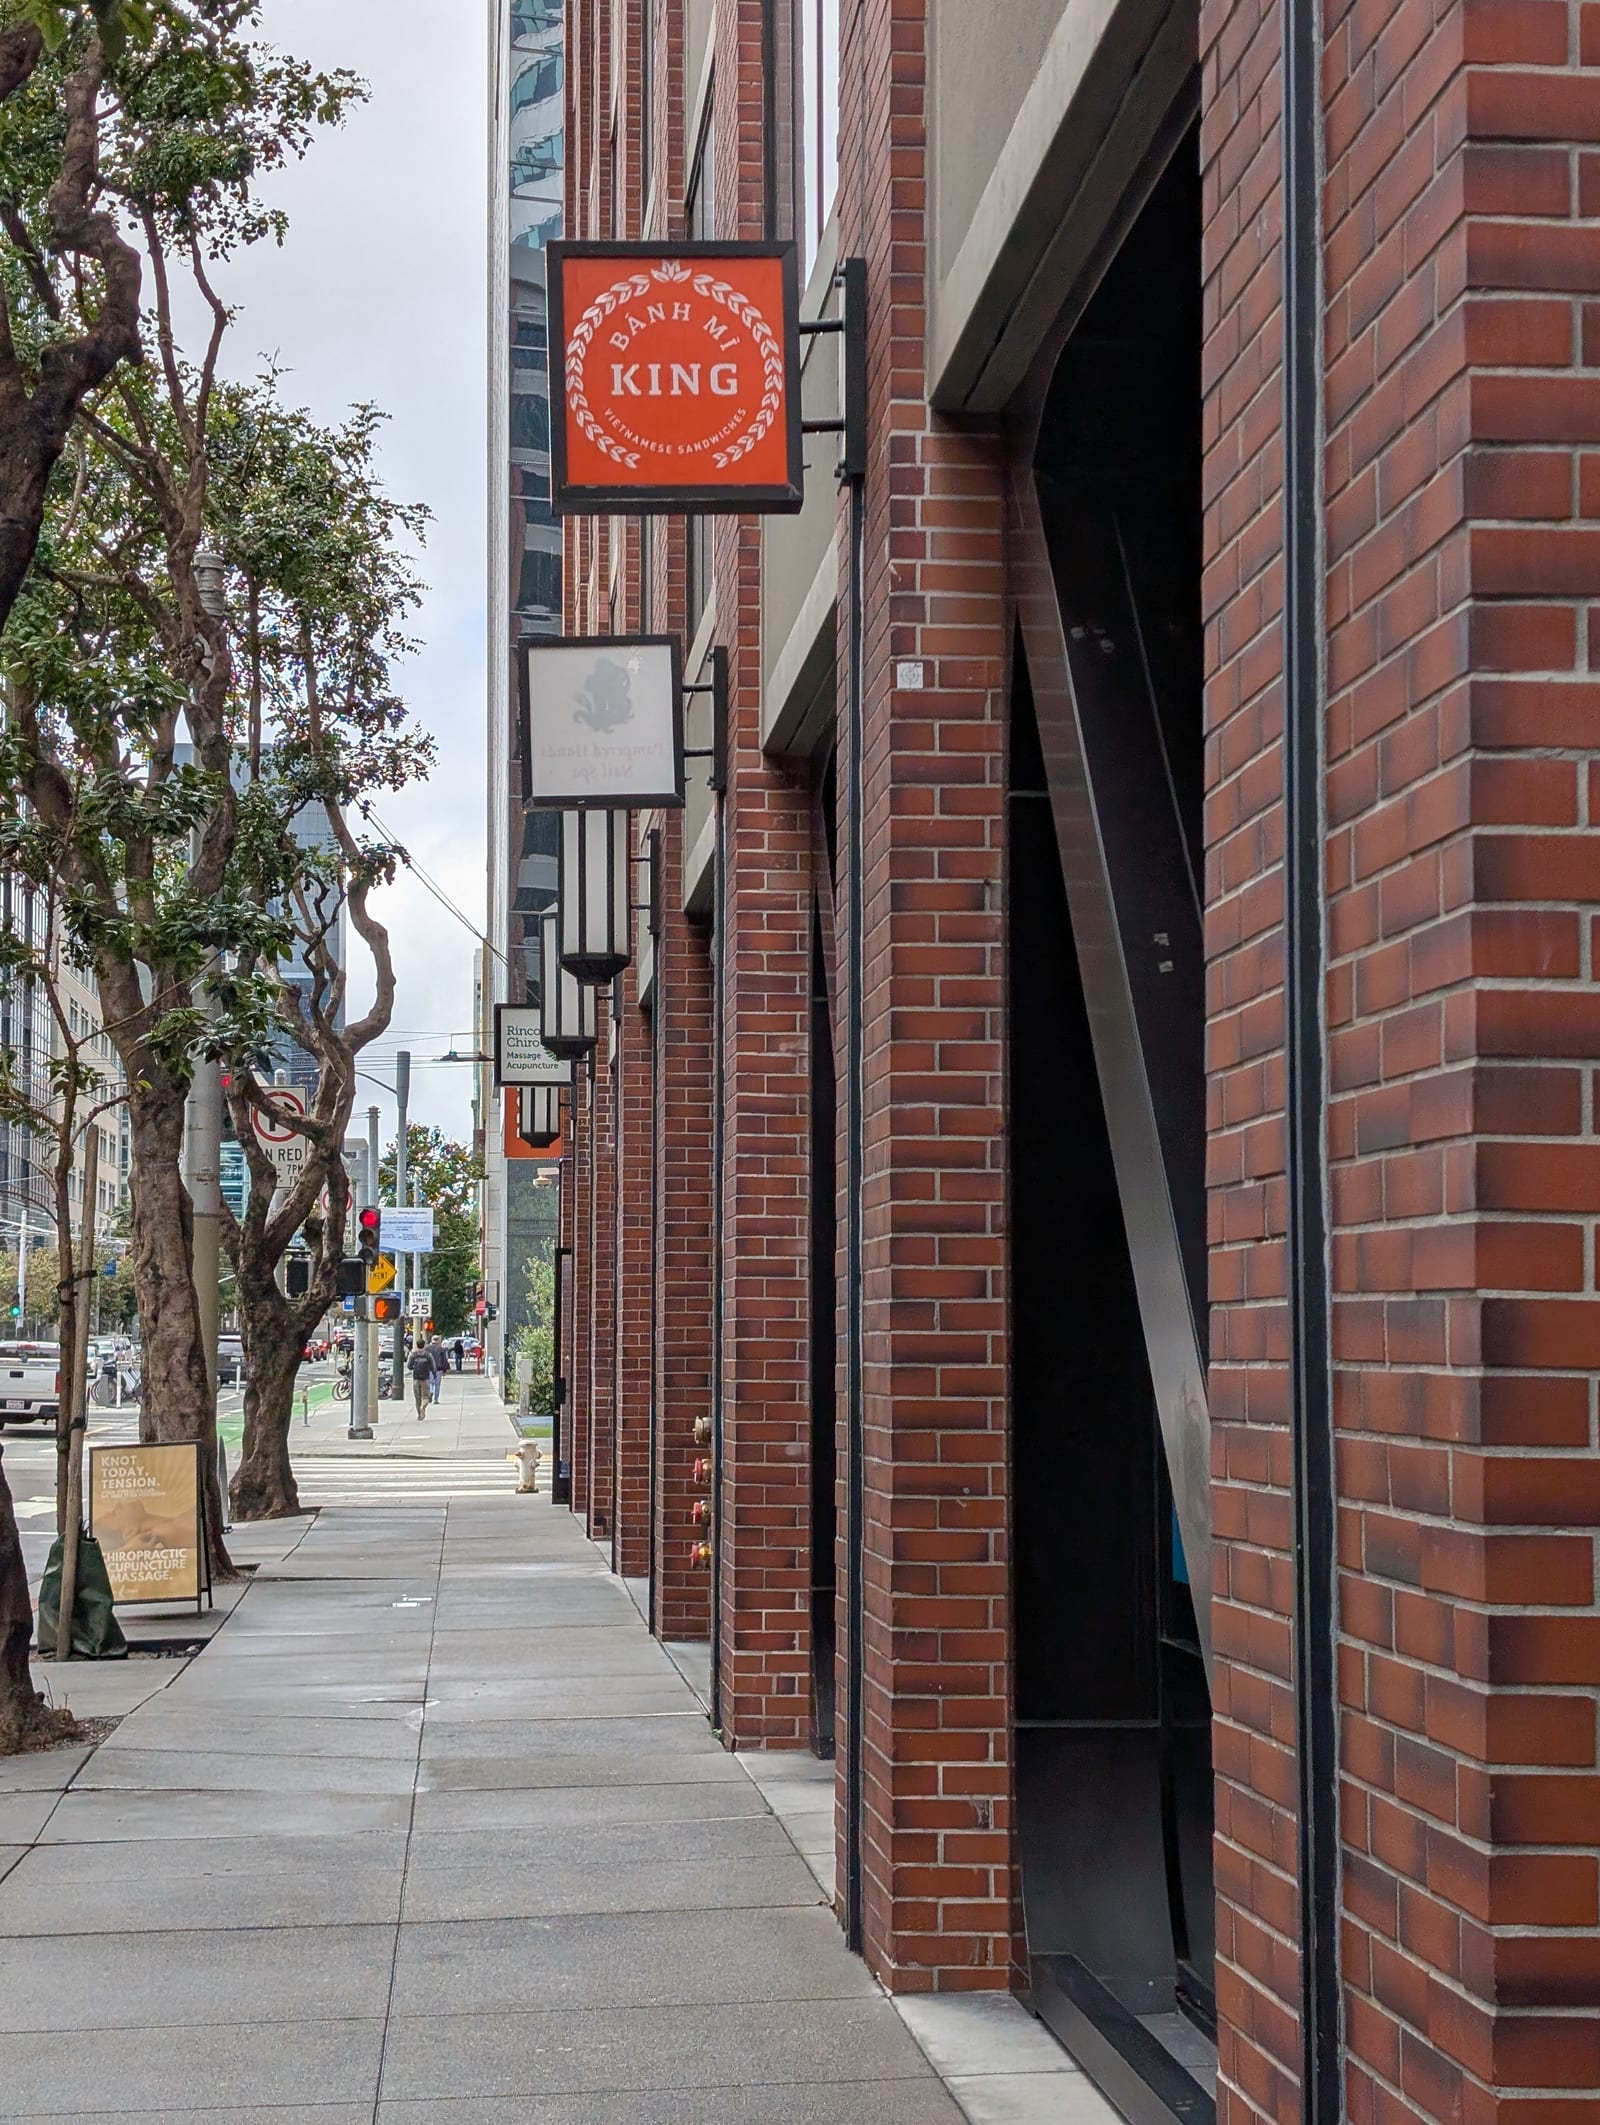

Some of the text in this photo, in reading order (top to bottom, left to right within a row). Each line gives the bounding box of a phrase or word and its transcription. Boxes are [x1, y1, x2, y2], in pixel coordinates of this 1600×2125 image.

[611, 363, 738, 396] KING
[604, 407, 746, 454] VIETNAMESE SANDWICHES
[507, 1025, 540, 1036] Rinco
[507, 1037, 540, 1047] Chiro
[507, 1051, 541, 1060] Massage
[507, 1061, 559, 1070] Acupuncture
[278, 1148, 303, 1161] RED
[411, 1304, 429, 1315] 25
[101, 1455, 137, 1467] KNOT
[101, 1477, 160, 1489] TENSION.
[107, 1559, 186, 1573] CUPUNCTURE
